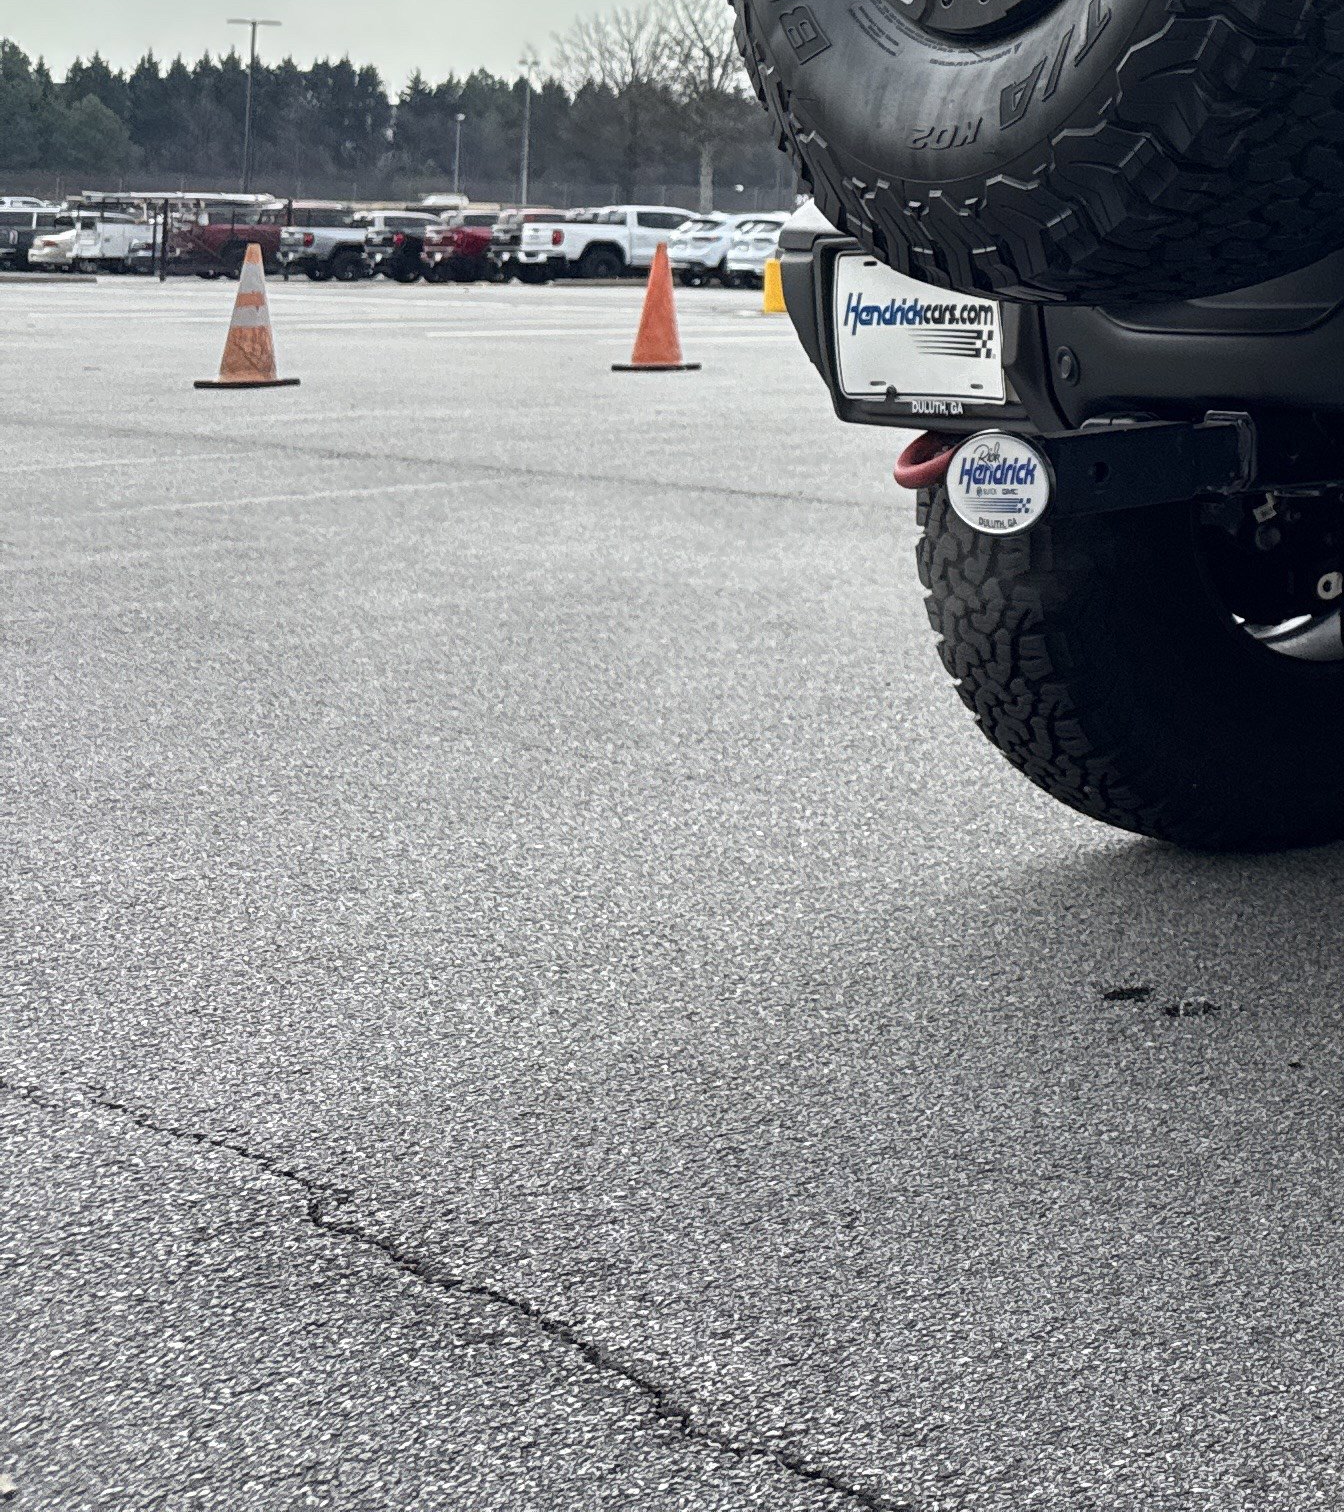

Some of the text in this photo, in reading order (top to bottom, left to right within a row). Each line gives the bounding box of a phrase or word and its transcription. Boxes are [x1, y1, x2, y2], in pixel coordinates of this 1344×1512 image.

[843, 292, 994, 336] Hendrickcars.com
[911, 400, 964, 416] DULUTH, GA
[959, 457, 1037, 494] Hendrick
